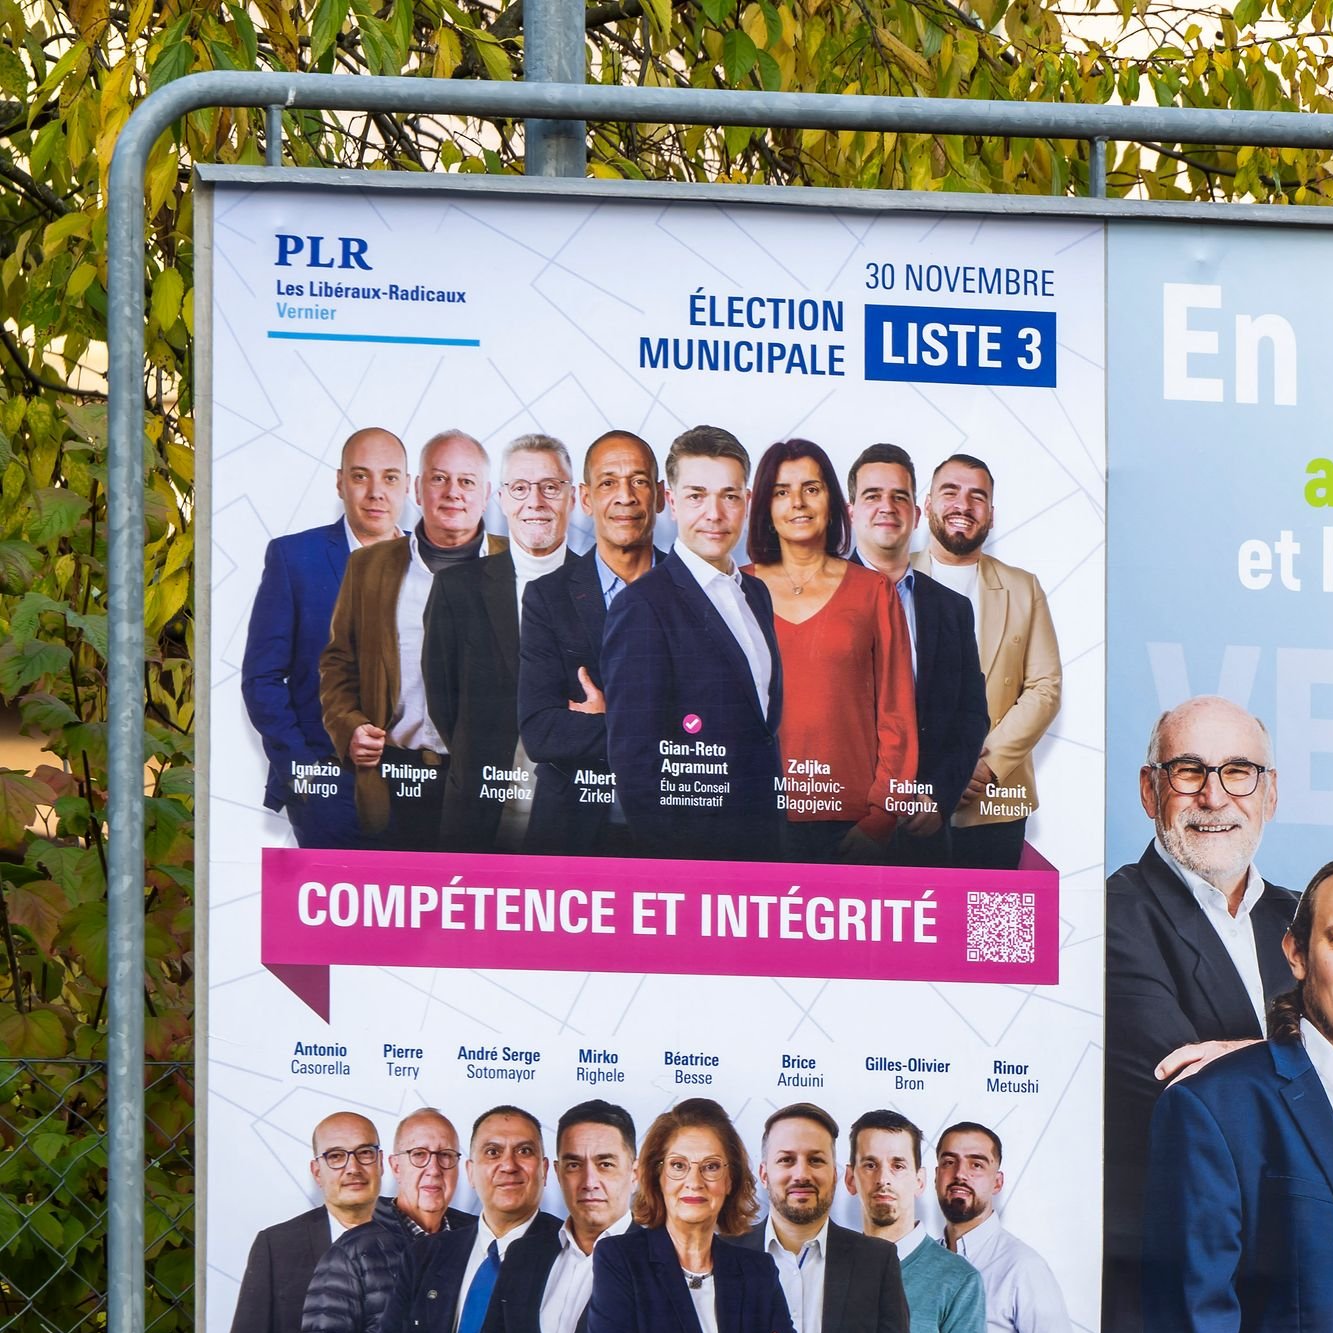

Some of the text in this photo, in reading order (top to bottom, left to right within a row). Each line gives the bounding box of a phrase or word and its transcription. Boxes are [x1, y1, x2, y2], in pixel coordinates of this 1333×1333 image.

[275, 234, 373, 270] PLR
[865, 263, 1055, 297] 30 NOVEMBRE
[277, 280, 466, 303] Les Libéraux-Radicaux
[277, 302, 336, 320] Vernier
[690, 287, 844, 331] ÉLECTION
[882, 321, 1041, 370] LISTE 3
[1163, 281, 1297, 406] En
[640, 337, 845, 376] MUNICIPALE
[1237, 530, 1301, 592] et
[659, 741, 726, 757] Gian-Reto
[291, 761, 340, 778] Ignazio
[381, 764, 437, 782] Philippe
[483, 765, 529, 782] Claude
[661, 758, 728, 777] Agramunt
[788, 760, 830, 776] Zeljka
[575, 769, 616, 785] Albert
[660, 778, 730, 793] Élu au Conseil
[294, 779, 338, 797] Murgo
[396, 783, 421, 798] Jud
[479, 784, 531, 802] Angeloz
[774, 777, 845, 795] Mihajlovic-
[889, 778, 933, 795] Fabien
[985, 783, 1026, 799] Granit
[579, 788, 615, 803] Zirkel
[660, 794, 723, 806] administratif
[777, 795, 842, 813] Blagojevic
[885, 797, 937, 814] Grognuz
[980, 800, 1032, 817] Metushi
[298, 874, 938, 944] COMPÉTENCE ET INTÉGRITÉ
[294, 1042, 347, 1058] Antonio
[383, 1044, 423, 1059] Pierre
[457, 1046, 540, 1065] André Serge
[579, 1049, 618, 1064] Mirko
[291, 1059, 350, 1076] Casorella
[664, 1050, 719, 1068] Béatrice
[782, 1054, 816, 1069] Brice
[865, 1056, 951, 1074] Gilles-Olivier
[993, 1060, 1028, 1075] Rinor
[387, 1062, 420, 1080] Terry
[466, 1064, 535, 1082] Sotomayor
[576, 1067, 624, 1085] Righele
[675, 1069, 712, 1086] Besse
[777, 1072, 823, 1088] Arduini
[895, 1075, 924, 1091] Bron
[986, 1078, 1039, 1094] Metushi
